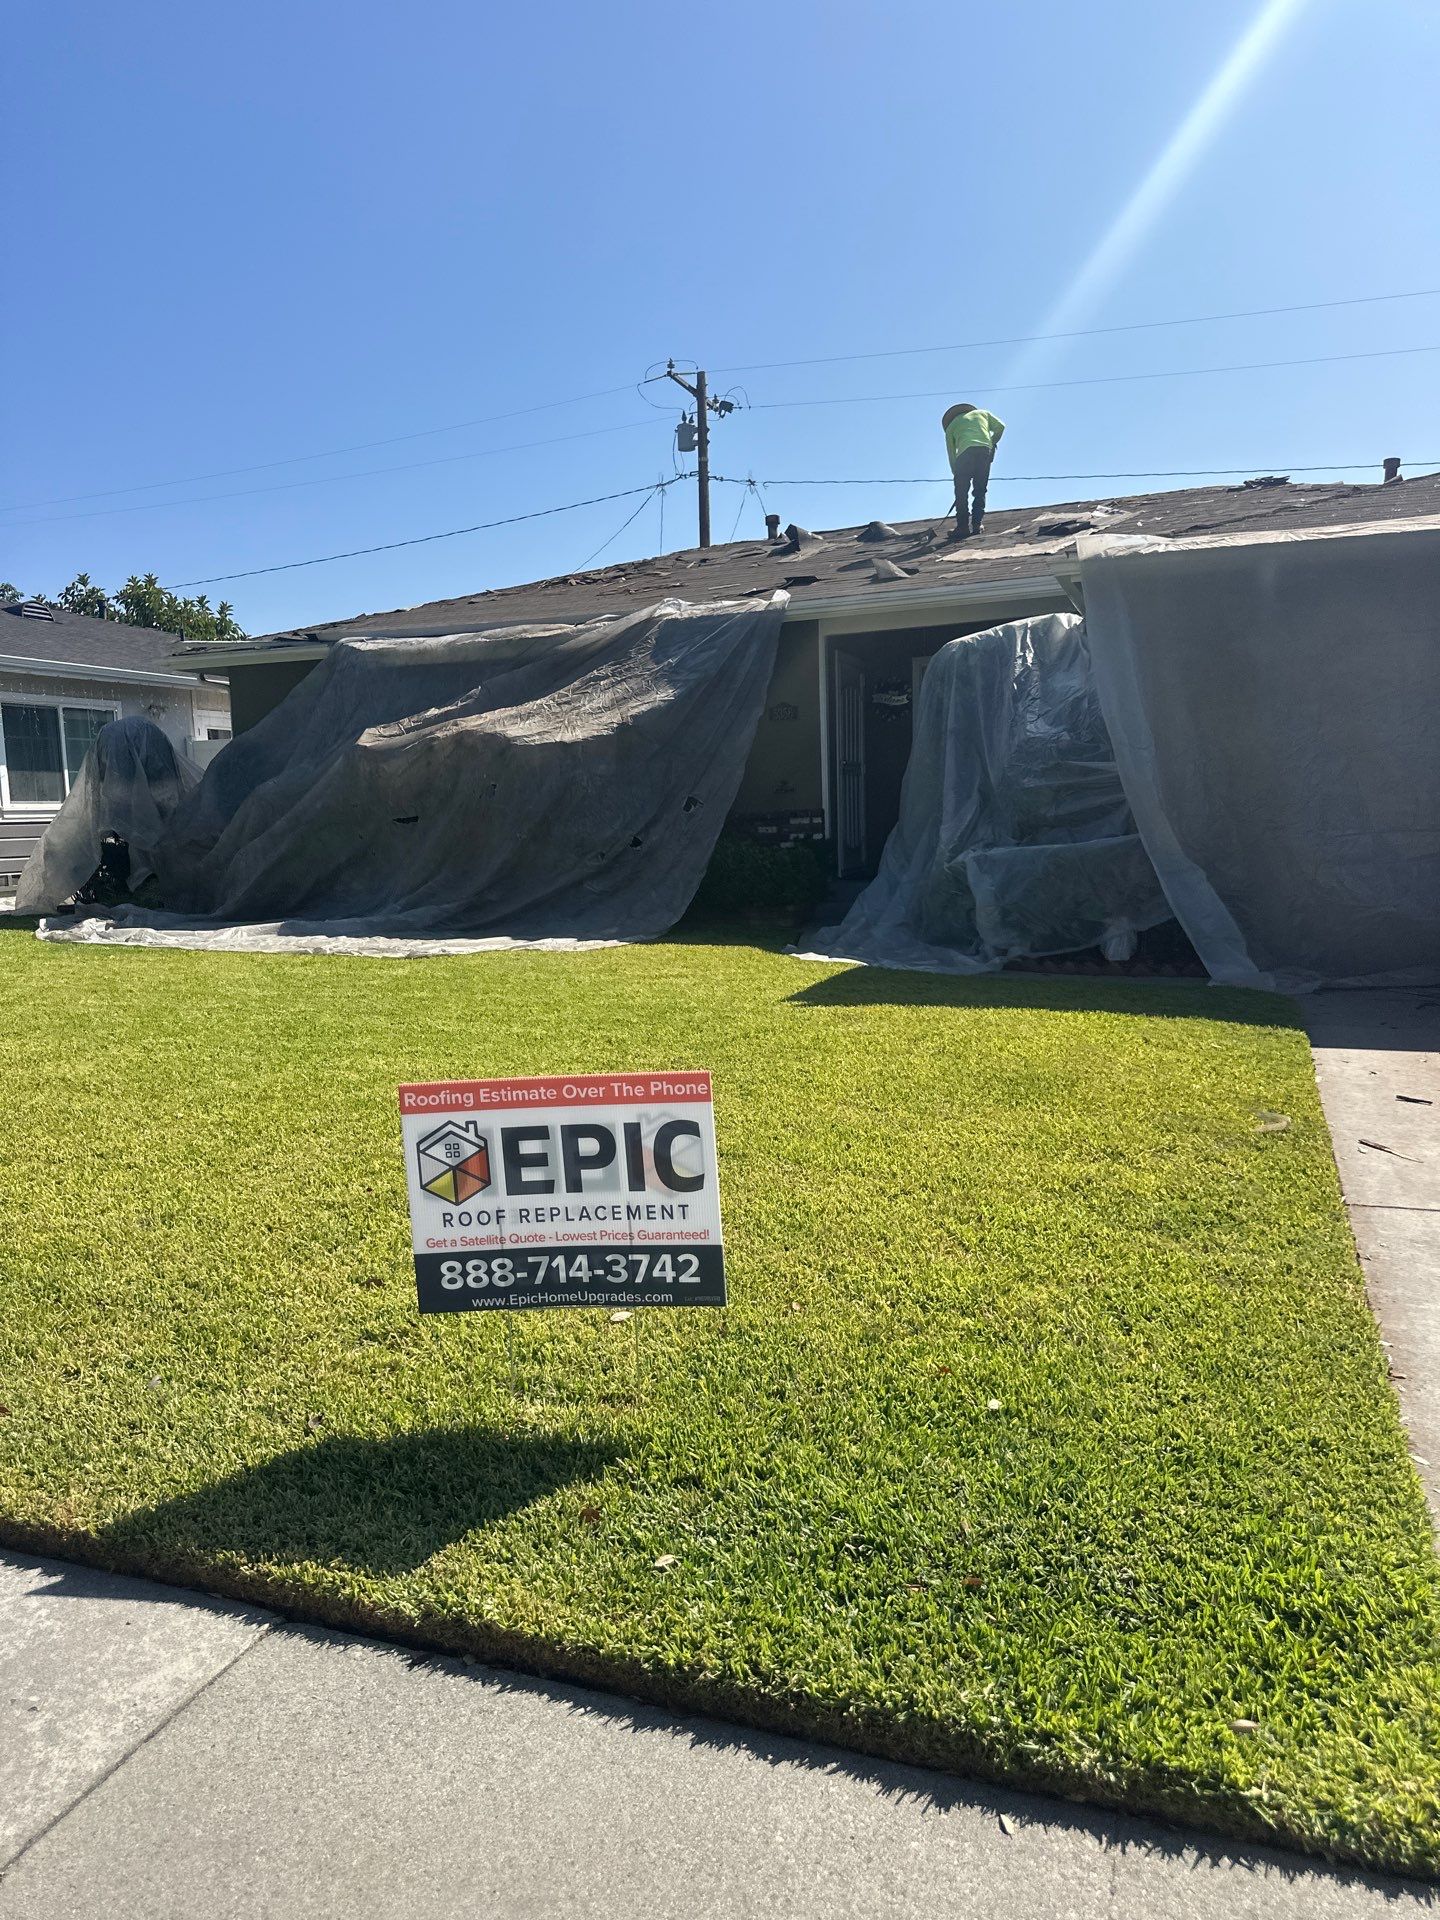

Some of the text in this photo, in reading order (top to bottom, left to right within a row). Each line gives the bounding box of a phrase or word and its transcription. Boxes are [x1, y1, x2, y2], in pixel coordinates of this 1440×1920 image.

[404, 1081, 708, 1107] Roofing Estimate Over The Phone
[500, 1119, 705, 1196] EPIC
[442, 1204, 689, 1228] ROOF REPLACEMENT
[426, 1237, 448, 1249] Get
[450, 1238, 457, 1247] a
[460, 1235, 506, 1247] Satellite
[509, 1233, 546, 1244] Quote
[555, 1231, 597, 1242] Lowest
[600, 1229, 633, 1241] Prices
[637, 1229, 710, 1240] Guaranteed!
[440, 1253, 701, 1290] 888-714-3742
[472, 1290, 673, 1307] www.EpicHomeUpgrades.com
